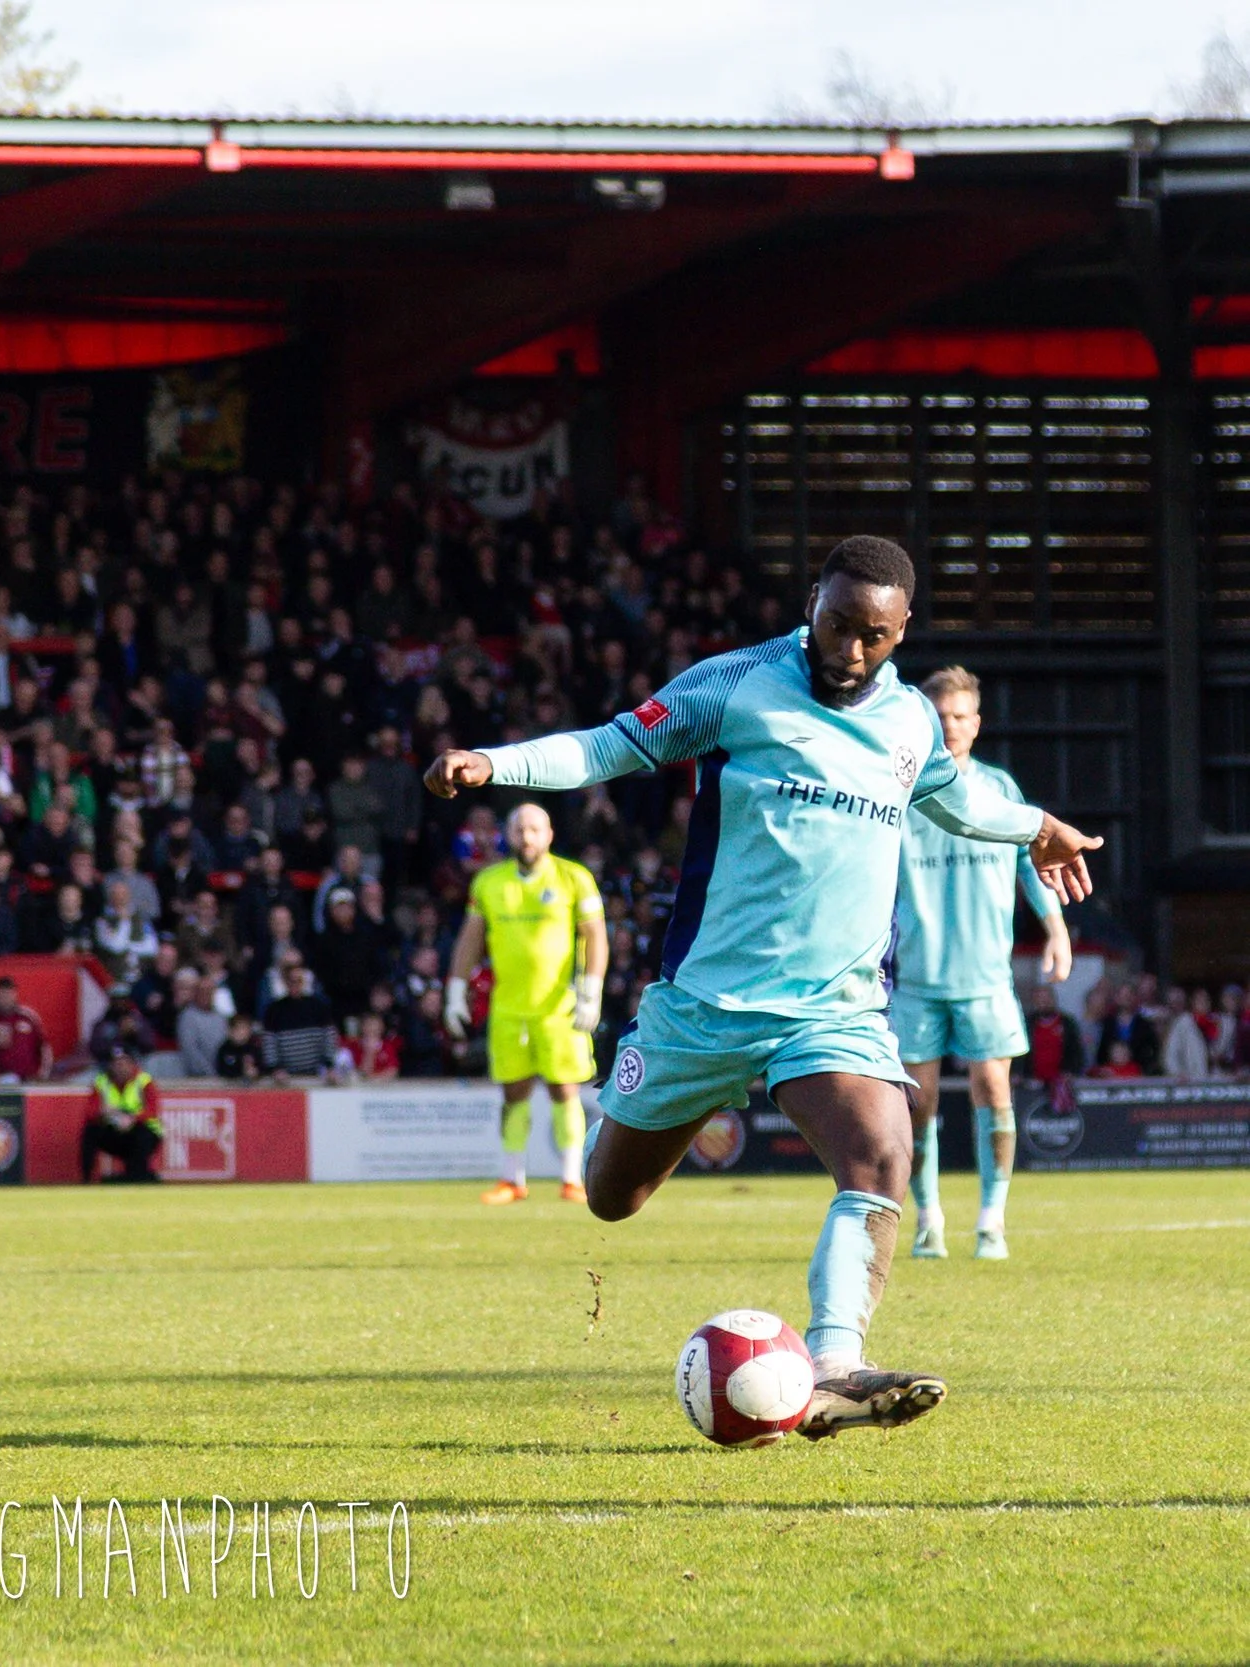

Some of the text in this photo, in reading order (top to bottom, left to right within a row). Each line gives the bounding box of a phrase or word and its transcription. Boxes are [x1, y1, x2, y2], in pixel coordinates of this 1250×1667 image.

[777, 780, 826, 805] THE
[912, 852, 1000, 868] THE PITMEN
